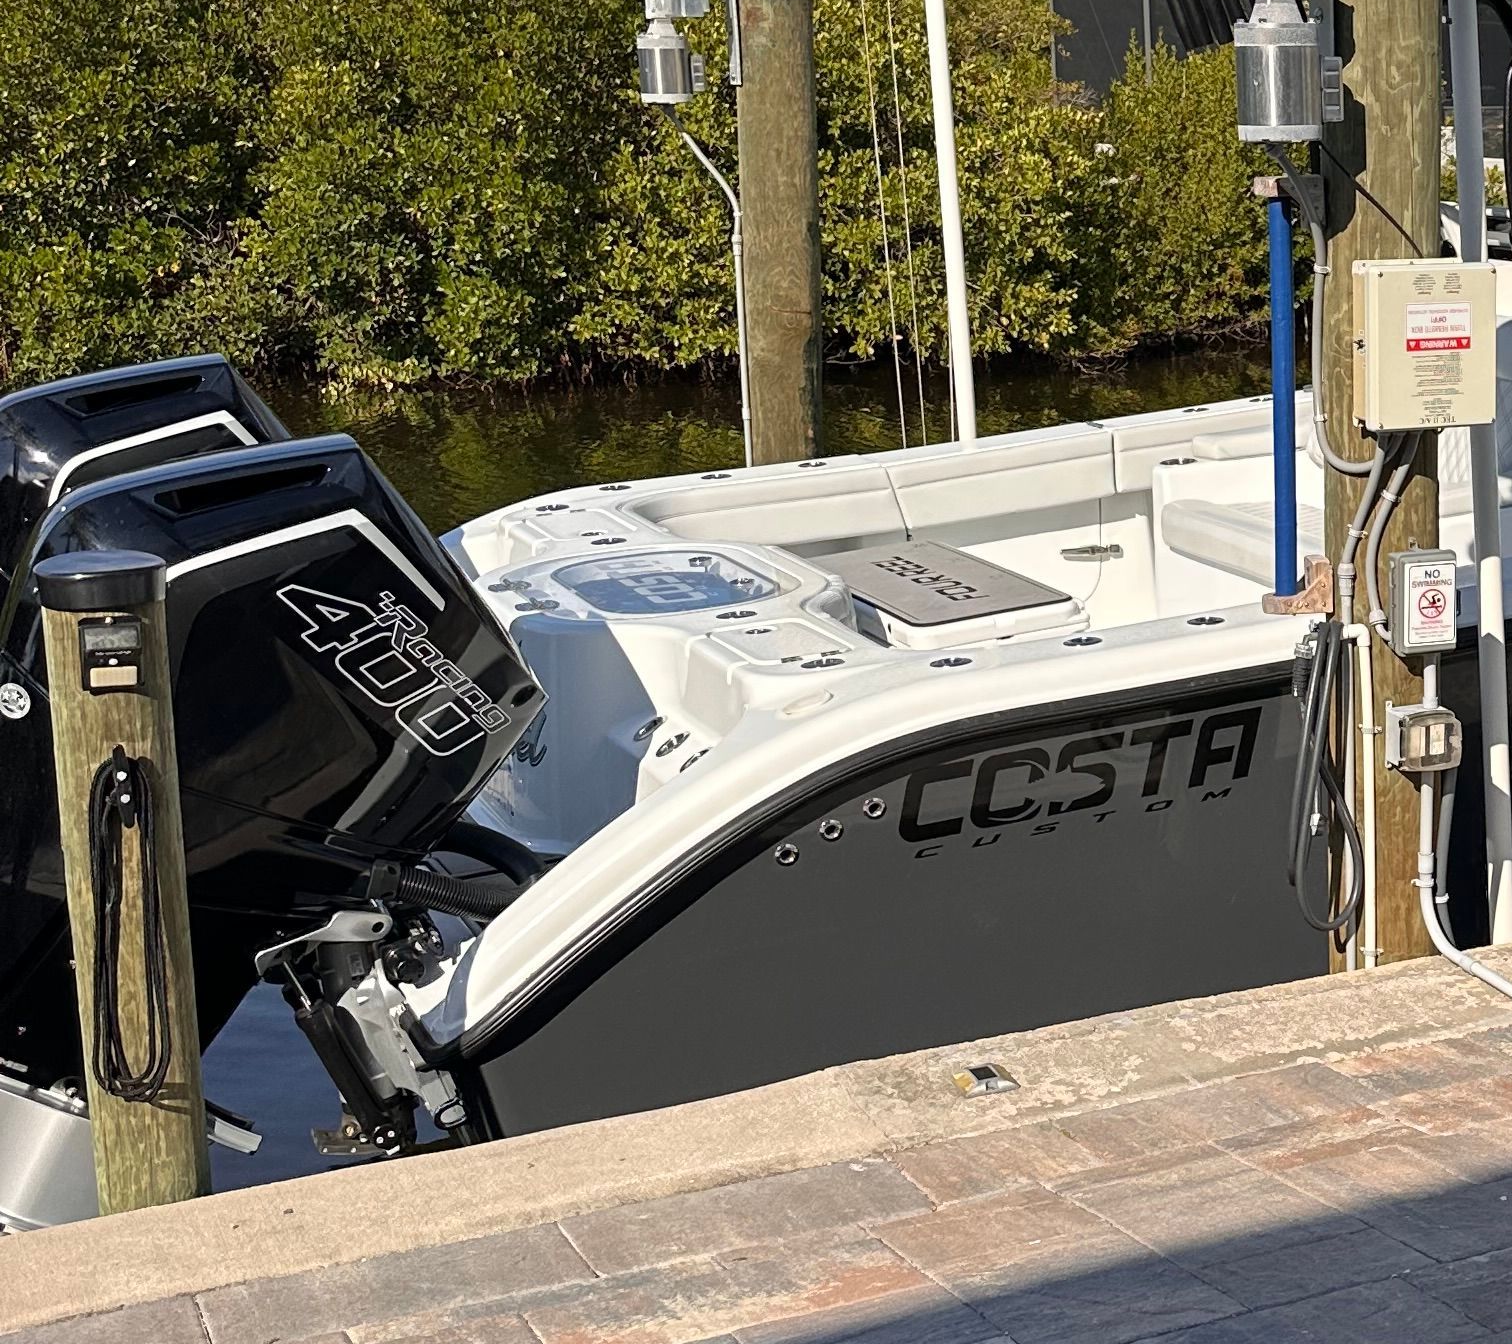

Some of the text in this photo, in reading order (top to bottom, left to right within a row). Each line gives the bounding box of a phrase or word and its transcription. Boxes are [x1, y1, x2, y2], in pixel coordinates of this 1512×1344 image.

[1425, 569, 1440, 578] NO
[276, 584, 485, 756] 400
[899, 707, 1263, 844] COSTA
[914, 787, 1232, 859] CUSTOM
